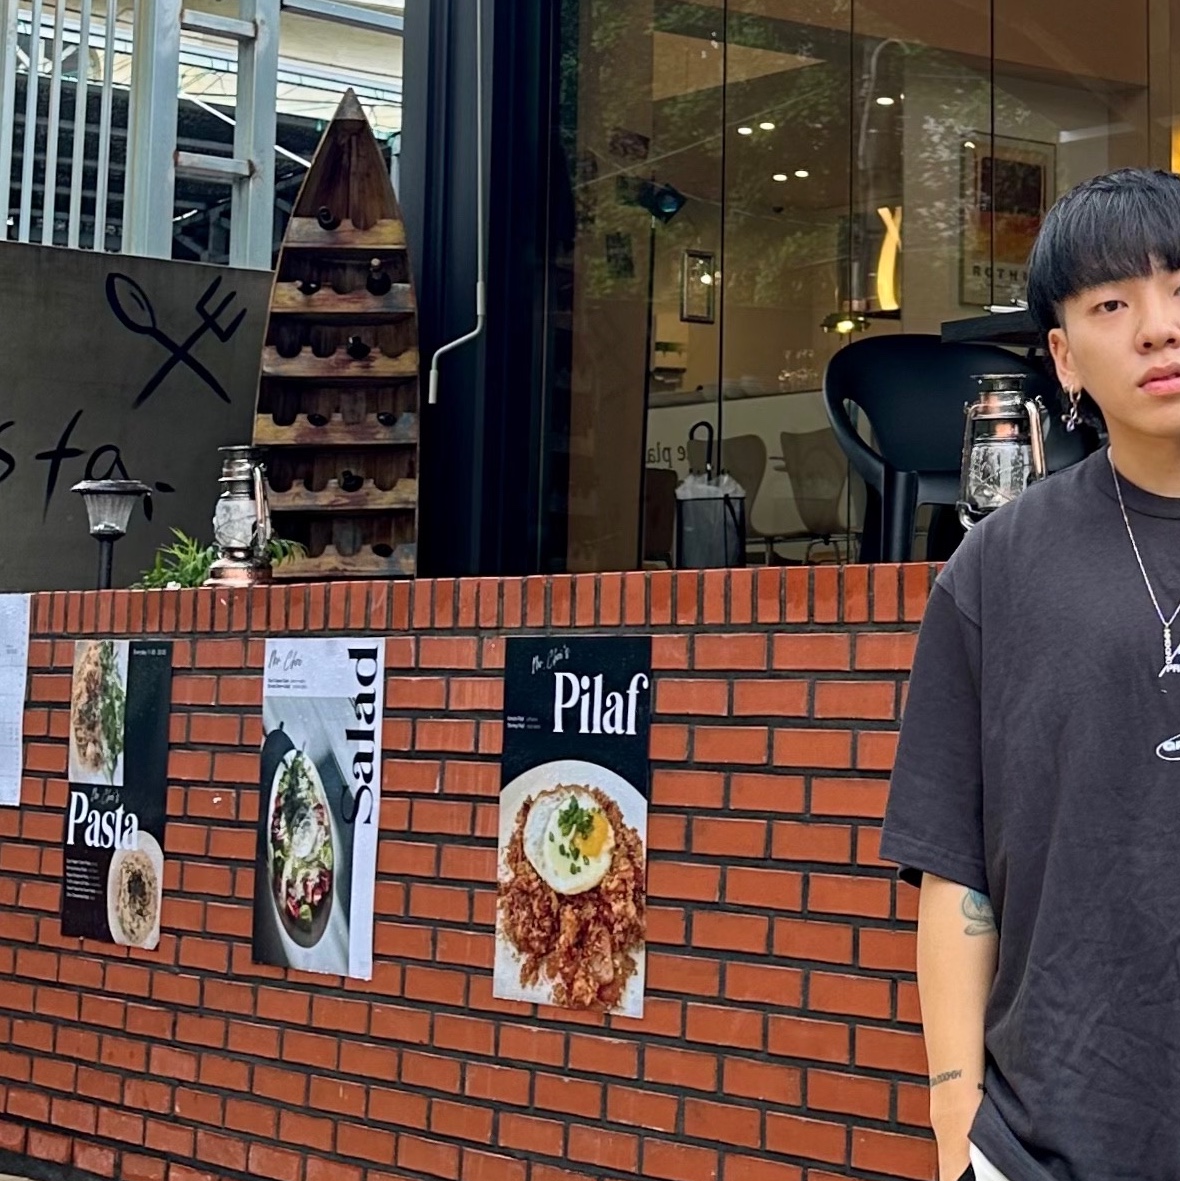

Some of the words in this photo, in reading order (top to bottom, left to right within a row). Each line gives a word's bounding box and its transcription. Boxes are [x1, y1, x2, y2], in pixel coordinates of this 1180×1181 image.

[972, 265, 1028, 282] ROTH
[552, 672, 649, 735] Pilaf
[340, 645, 379, 825] Salad
[67, 791, 139, 851] Pasta
